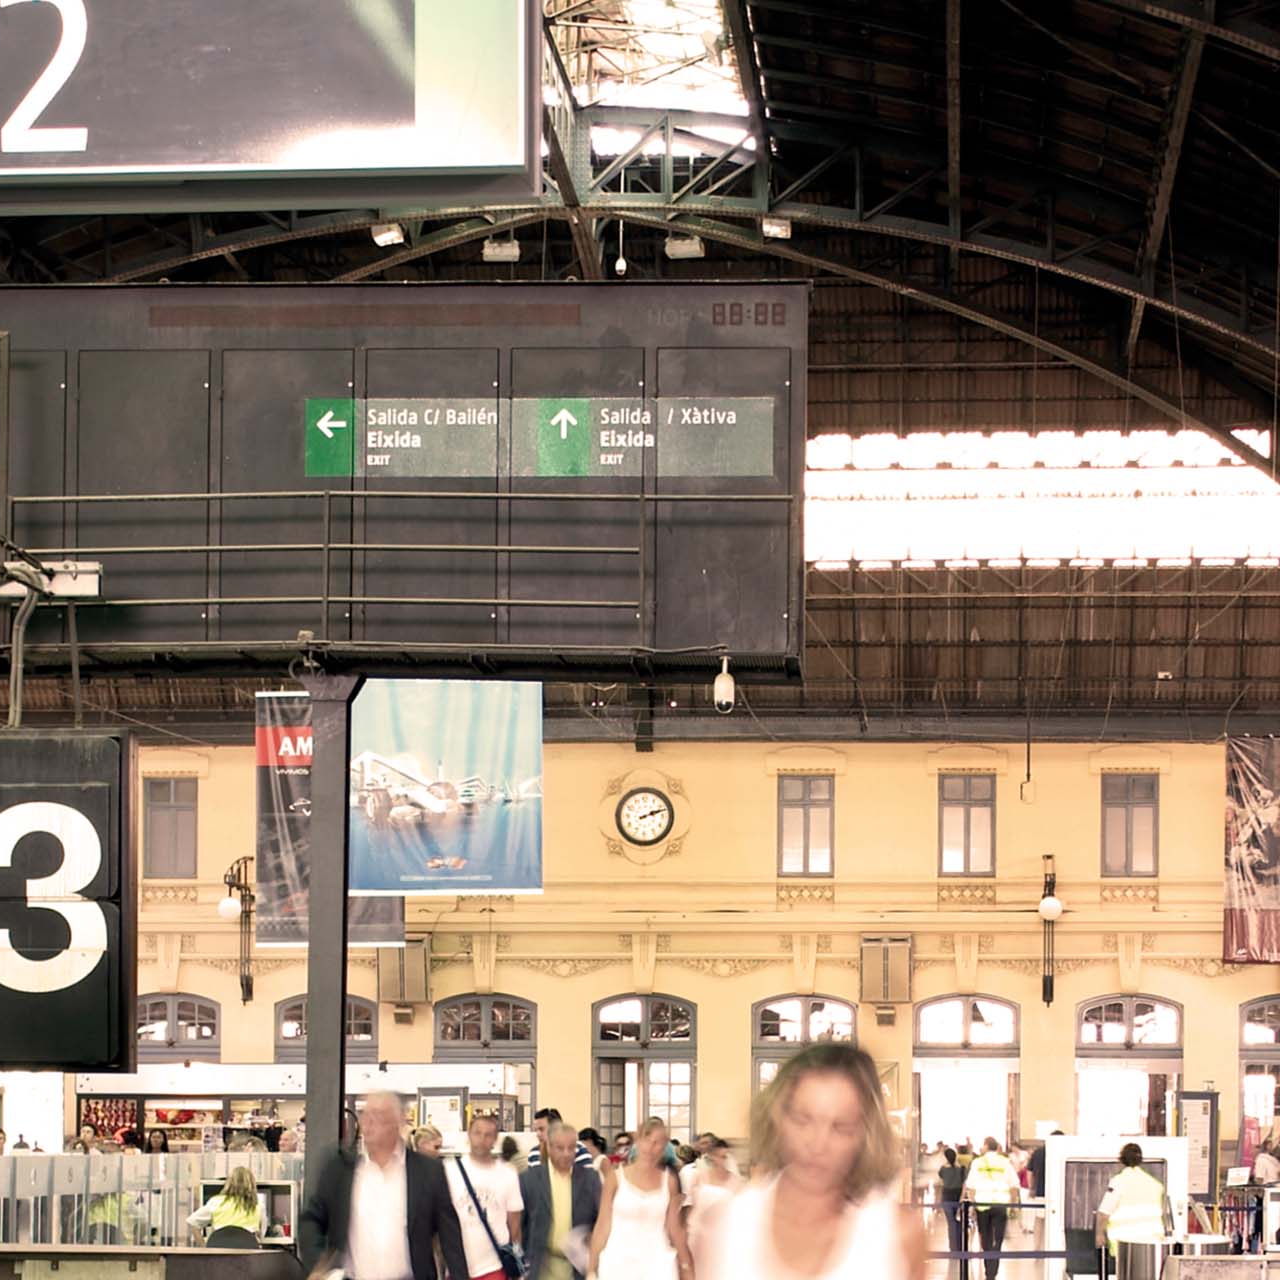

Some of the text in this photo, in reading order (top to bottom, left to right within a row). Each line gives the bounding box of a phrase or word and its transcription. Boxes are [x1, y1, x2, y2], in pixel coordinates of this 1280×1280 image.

[0, 0, 89, 153] 2
[367, 408, 497, 425] Salida C/ Bailén
[600, 408, 651, 425] Salida
[680, 407, 737, 425] Xàtiva
[367, 430, 422, 448] Eixida
[600, 430, 655, 447] Eixida
[367, 454, 391, 465] EXIT
[600, 453, 624, 465] EXIT
